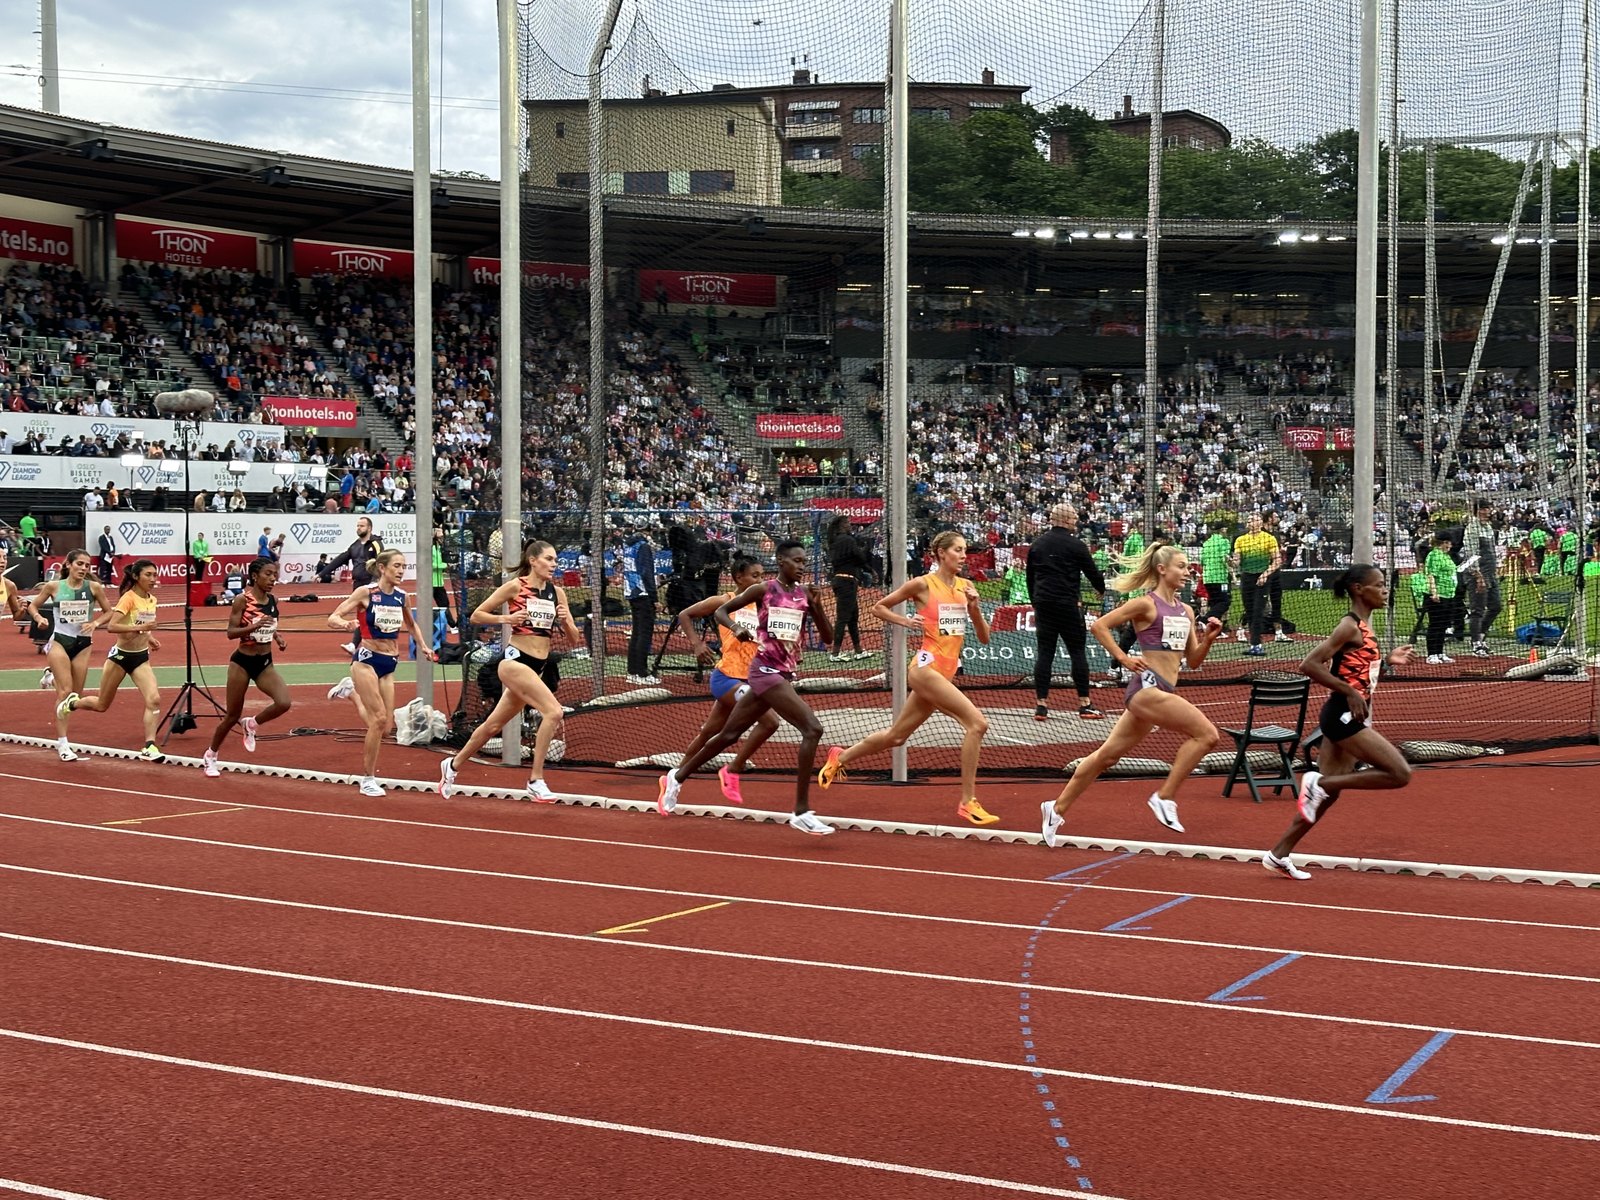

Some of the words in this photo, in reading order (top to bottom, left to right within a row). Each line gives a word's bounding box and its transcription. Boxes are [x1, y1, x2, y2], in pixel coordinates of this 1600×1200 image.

[0, 229, 69, 256] tels.no
[152, 229, 215, 254] THON
[165, 252, 202, 264] HOTELS
[331, 250, 392, 272] THON
[680, 275, 738, 293] THON
[1287, 430, 1323, 442] THON
[220, 522, 242, 531] OSLO
[386, 522, 408, 530] OSLO
[141, 529, 174, 537] DIAMOND
[213, 530, 249, 538] BISLETT
[312, 529, 343, 537] DIAMOND
[380, 530, 415, 538] BISLETT
[140, 537, 168, 545] LEAGUE
[216, 538, 247, 546] GAMES
[311, 536, 337, 544] LEAGUE
[383, 537, 413, 545] GAMES
[49, 570, 56, 580] 7
[768, 620, 801, 632] JEBITOK
[920, 653, 928, 662] 5
[962, 646, 1014, 660] OSLO
